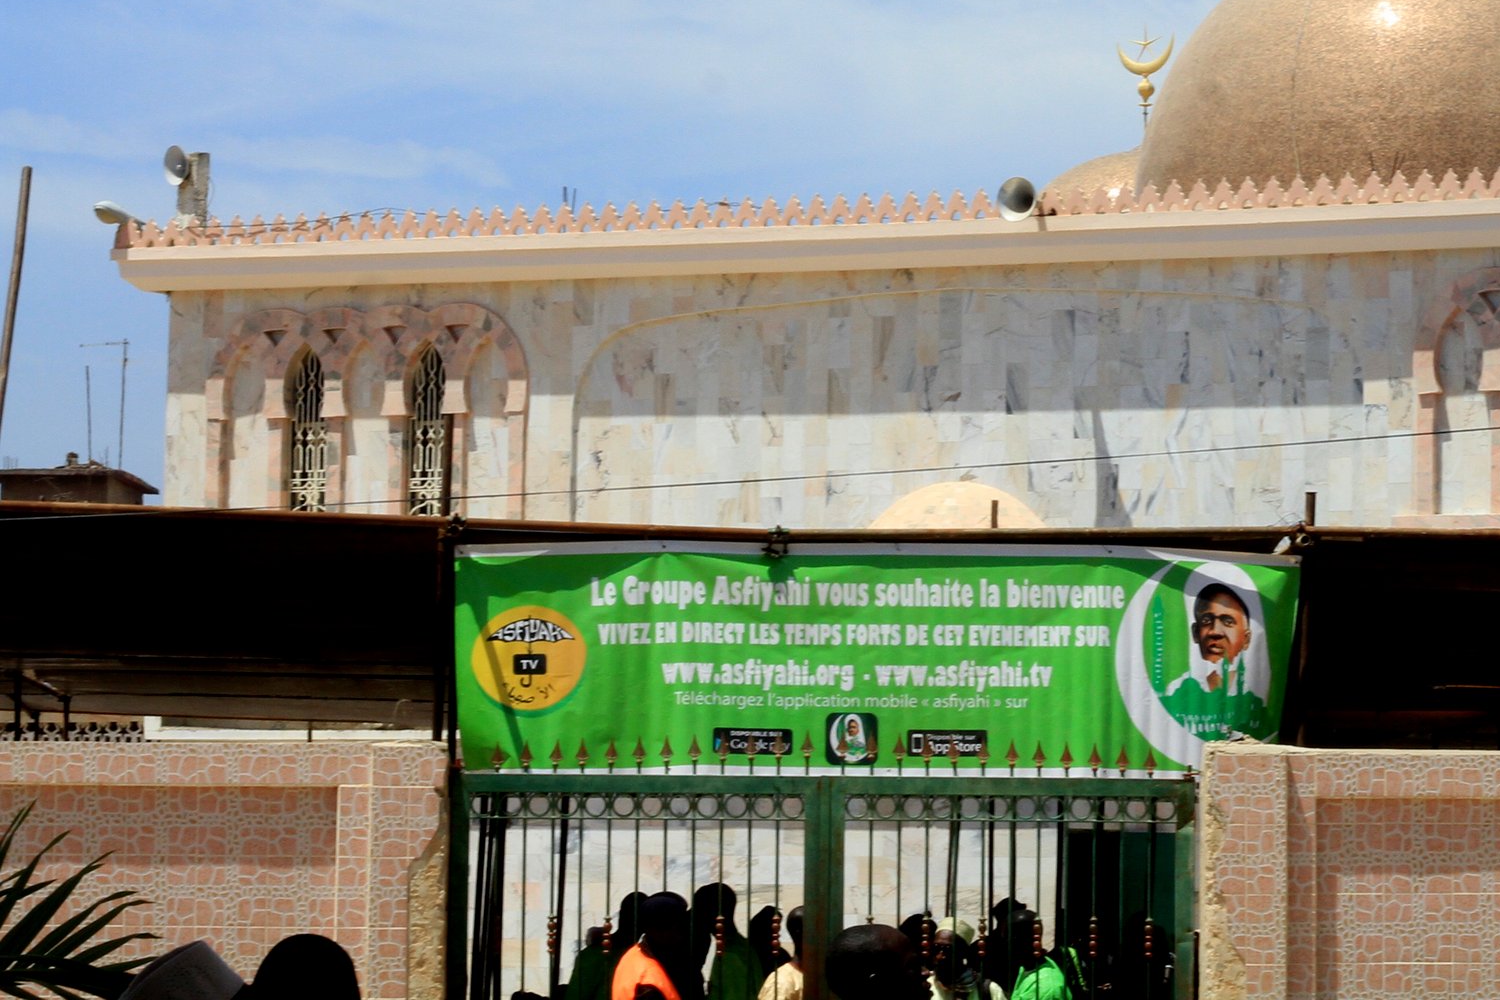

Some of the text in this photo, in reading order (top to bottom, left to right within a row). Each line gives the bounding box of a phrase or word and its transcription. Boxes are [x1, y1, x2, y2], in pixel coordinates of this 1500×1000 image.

[591, 575, 1124, 612] Le Groupe Asfiyahi vous souhaite la bienvenue
[598, 621, 1110, 647] VIVEZ EN DIRECT LES TEMPS FORTS DE CET EVENEMENT SUR
[520, 660, 539, 670] TV
[661, 658, 855, 691] www.asfiyahi.org
[874, 660, 1052, 693] www.asfiyahi.tv
[674, 691, 764, 710] Téléchargez
[865, 694, 918, 708] mobile
[932, 693, 990, 711] asfiyahi
[1005, 697, 1028, 709] sur
